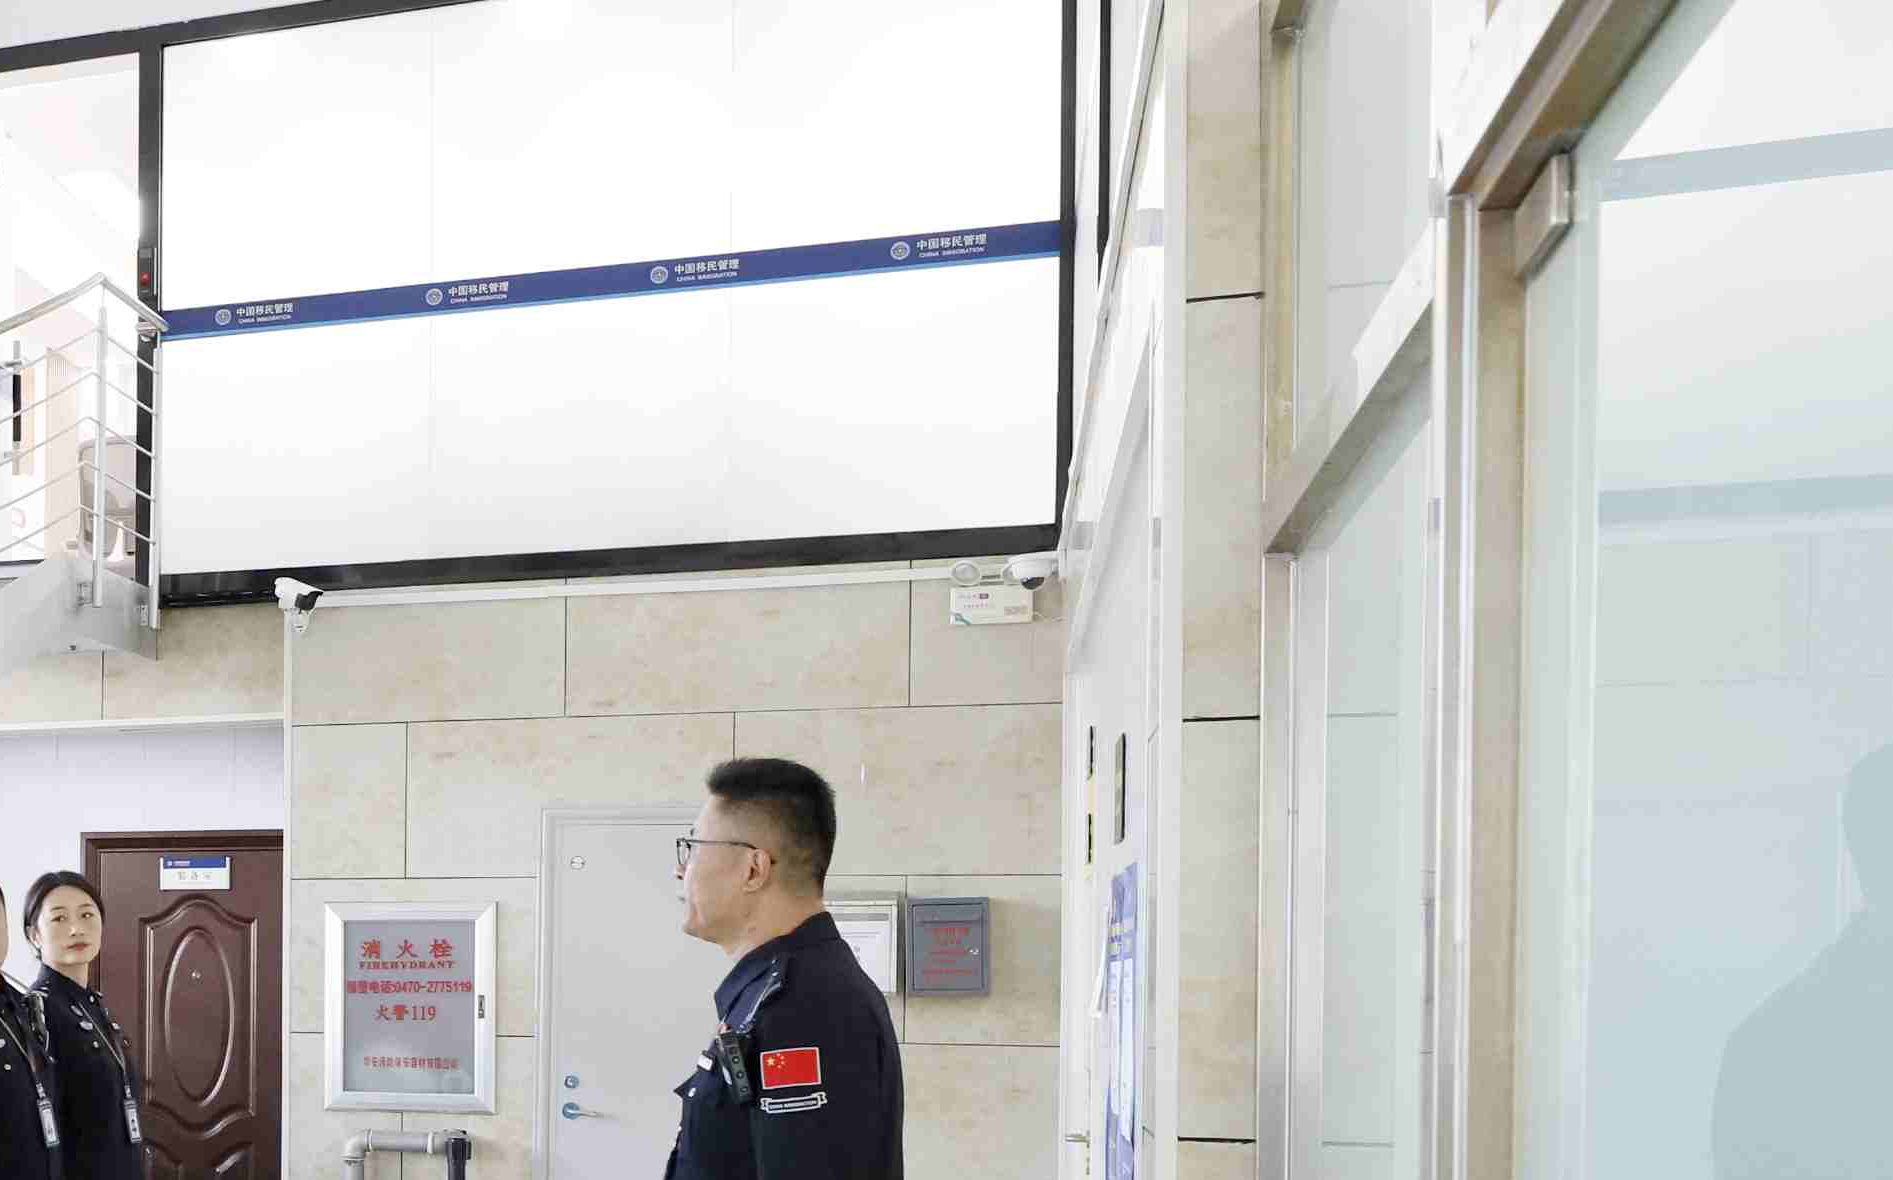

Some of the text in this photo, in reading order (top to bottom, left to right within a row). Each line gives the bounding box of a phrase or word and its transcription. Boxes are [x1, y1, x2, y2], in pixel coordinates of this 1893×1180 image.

[915, 233, 988, 251] 中国移民管理
[674, 259, 740, 275] 中国移民管理
[448, 281, 509, 297] 中国移民管理
[236, 303, 294, 317] 中国移民管理
